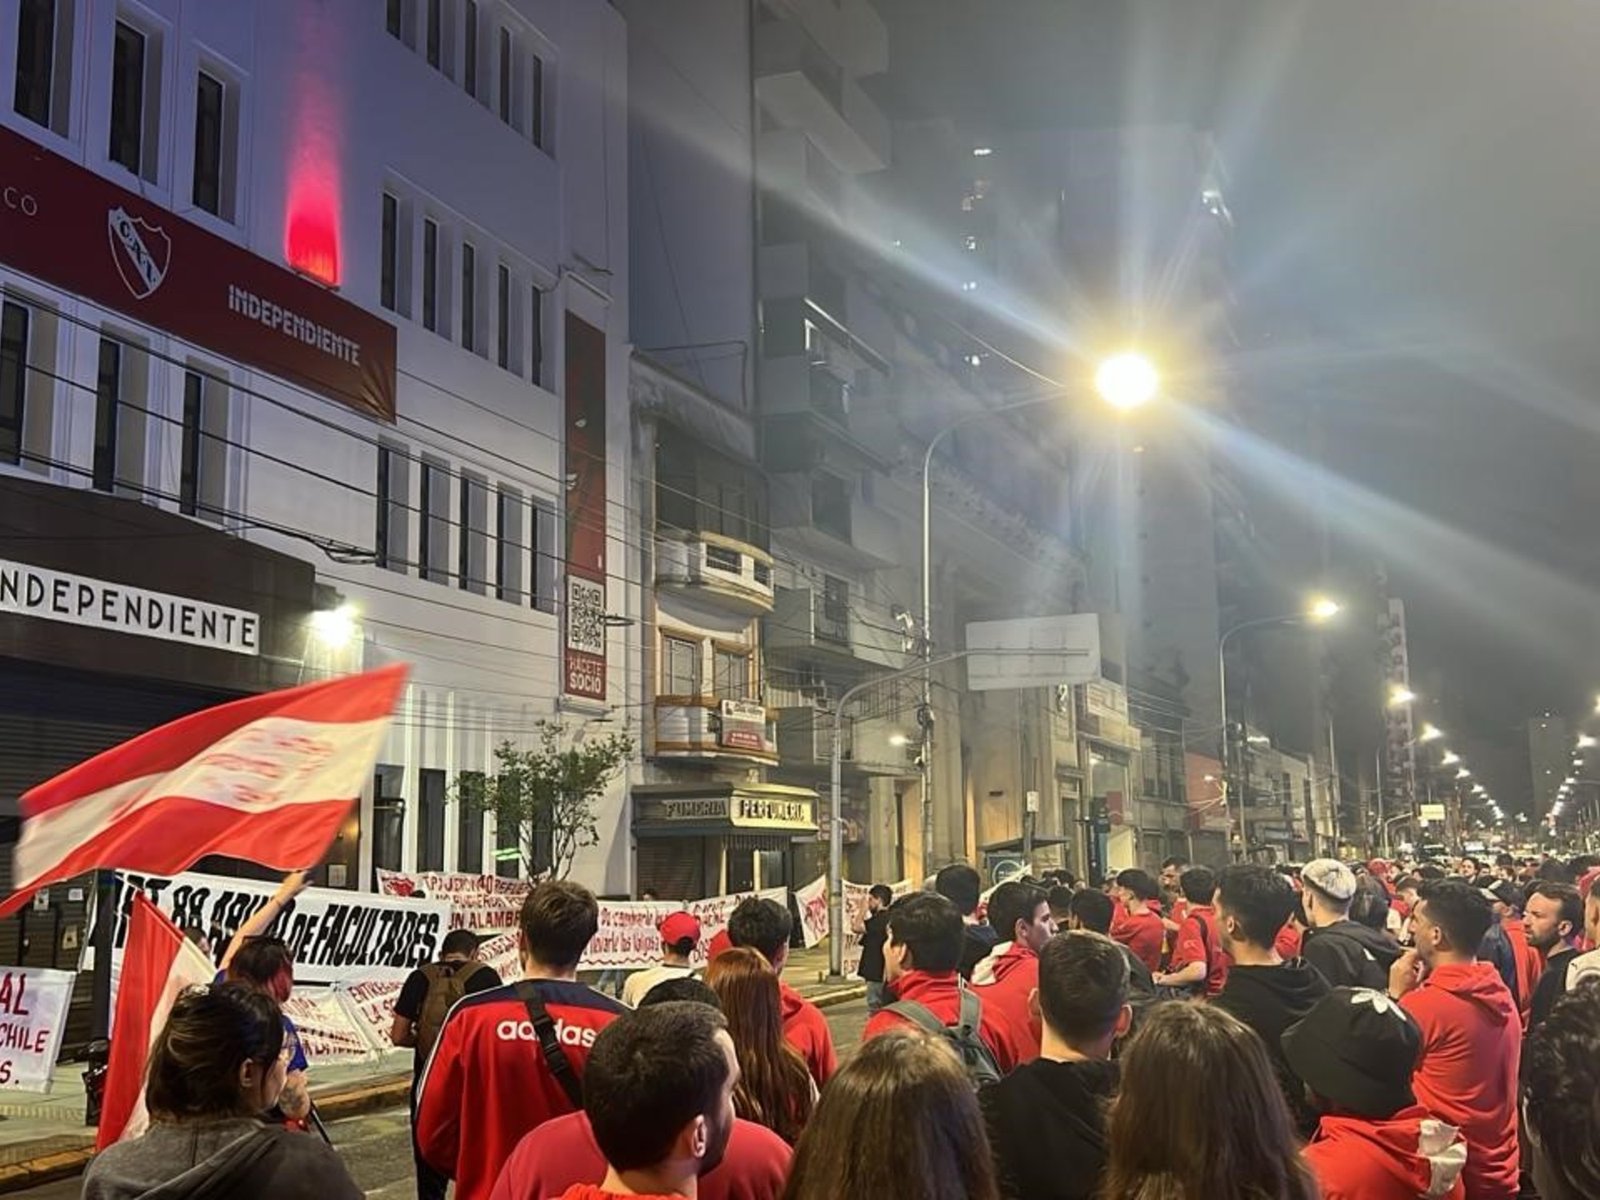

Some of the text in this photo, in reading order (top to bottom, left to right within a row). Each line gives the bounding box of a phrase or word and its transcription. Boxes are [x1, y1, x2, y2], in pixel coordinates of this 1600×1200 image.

[228, 284, 361, 367] INDEPENDIENTE
[569, 672, 602, 694] SOCIO
[312, 904, 440, 968] FACULTADES
[497, 1018, 596, 1048] adas
